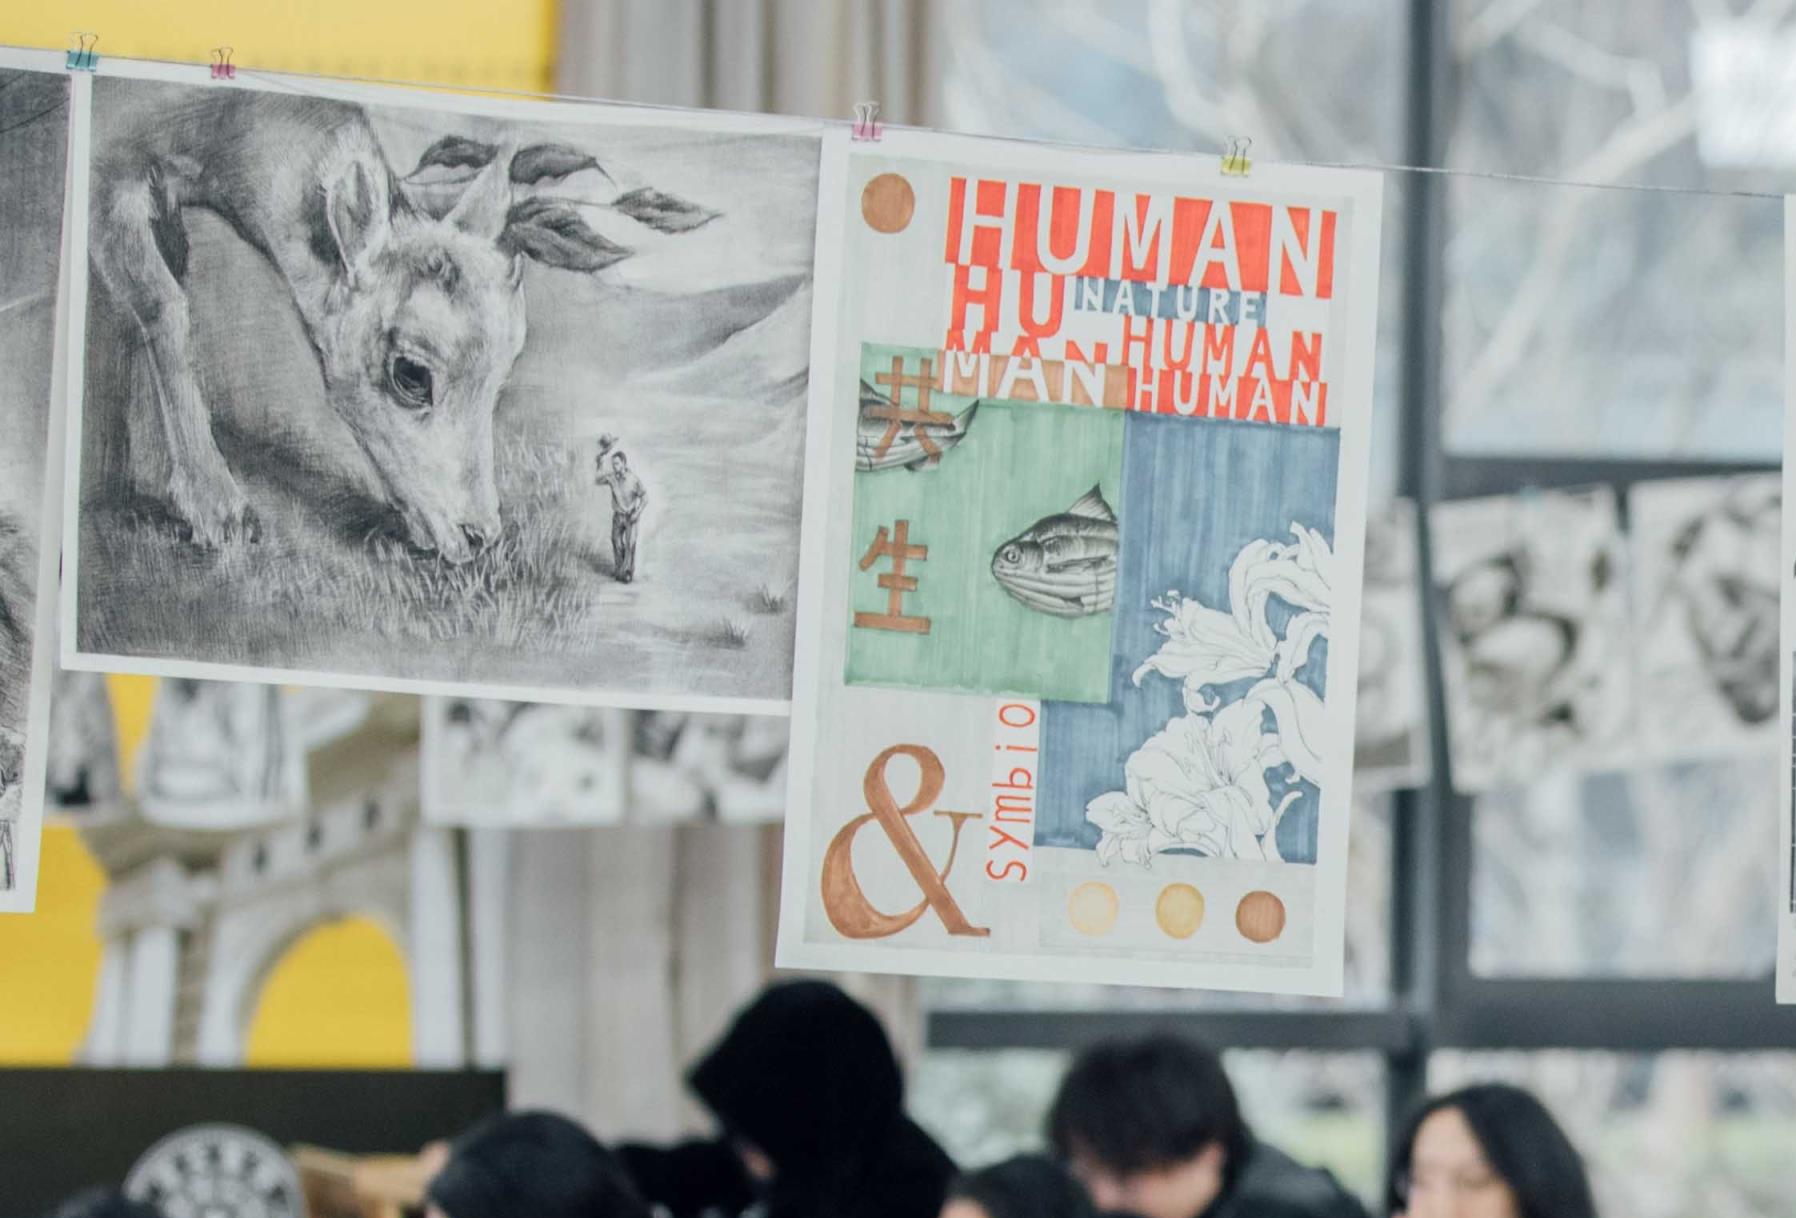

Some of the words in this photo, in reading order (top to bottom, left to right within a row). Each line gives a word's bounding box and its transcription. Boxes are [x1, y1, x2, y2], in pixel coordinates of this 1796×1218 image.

[957, 177, 1324, 298] HUMAN
[951, 264, 1066, 339] HU
[1080, 276, 1260, 326] NATURE
[942, 329, 1108, 408] MAN
[1121, 315, 1323, 382] HUMAN
[1134, 367, 1323, 428] HUMAN
[853, 355, 955, 635] 共生
[820, 743, 991, 939] &
